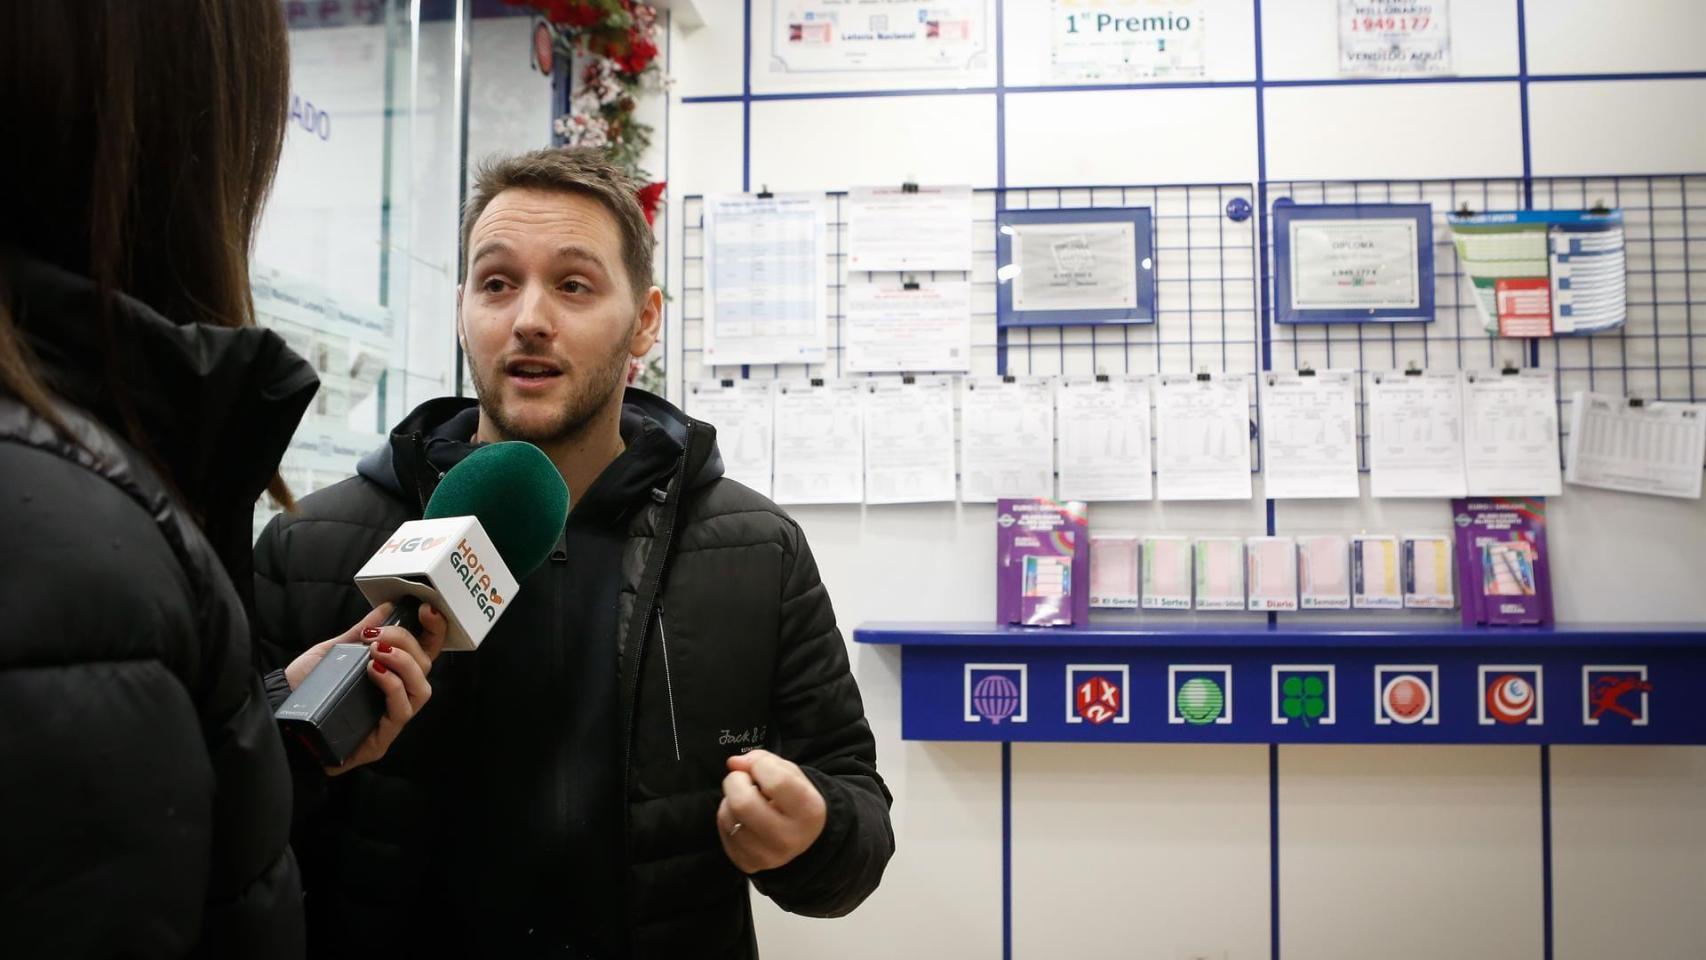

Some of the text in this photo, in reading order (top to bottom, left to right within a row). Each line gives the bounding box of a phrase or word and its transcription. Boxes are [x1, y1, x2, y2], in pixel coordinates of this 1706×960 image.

[1097, 10, 1191, 32] Premio
[449, 551, 497, 623] GALEGA
[1266, 600, 1294, 608] Diario
